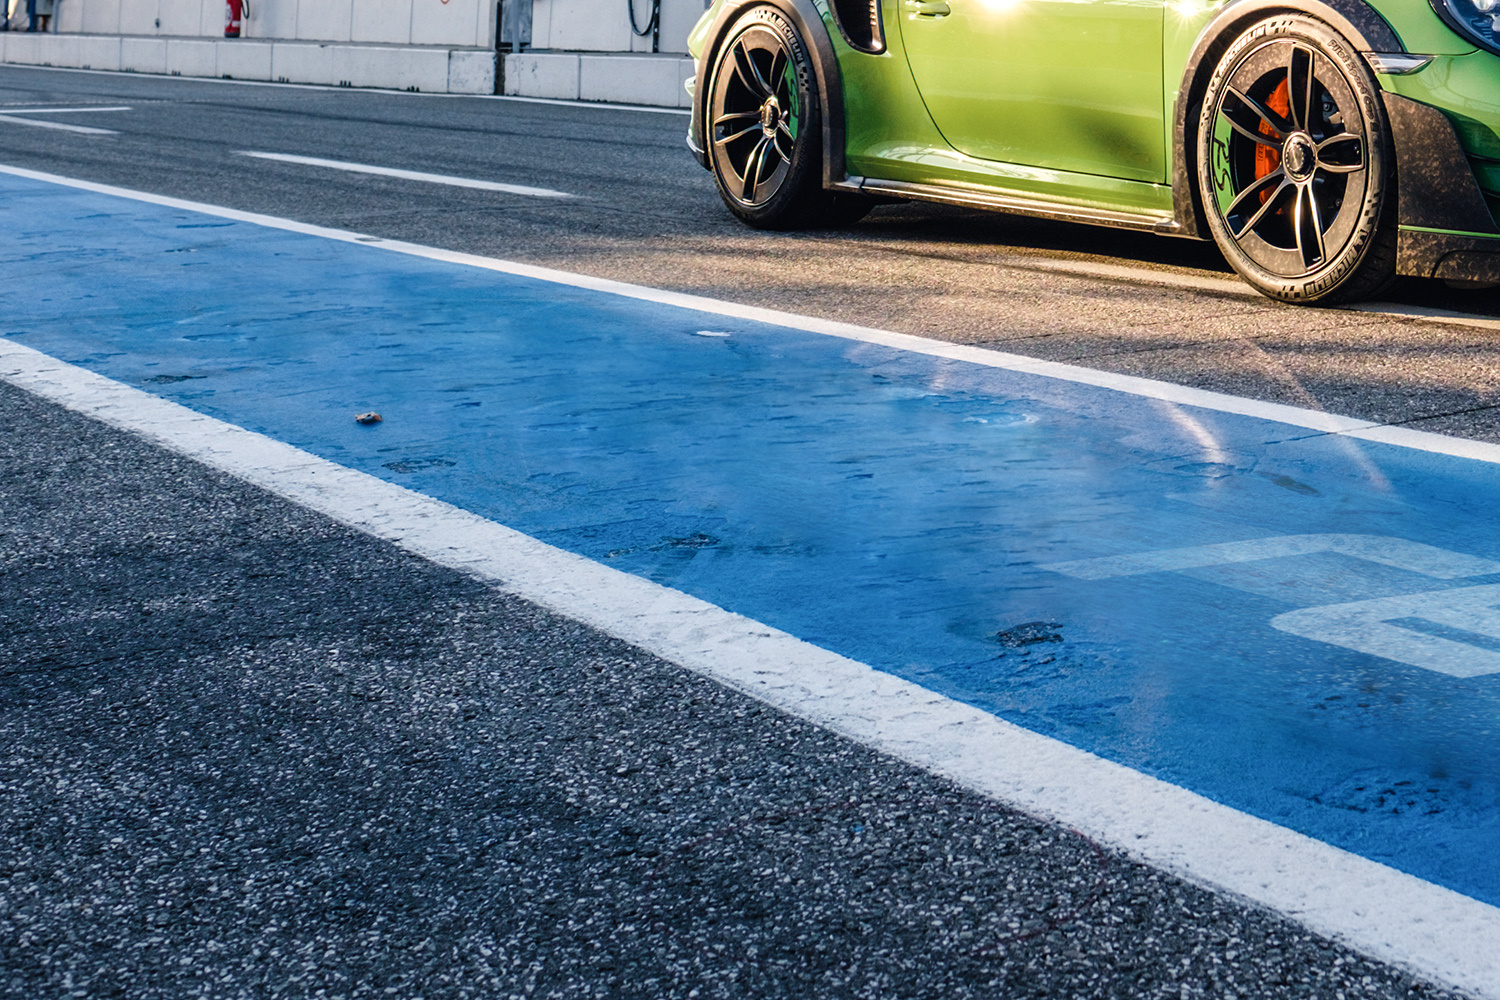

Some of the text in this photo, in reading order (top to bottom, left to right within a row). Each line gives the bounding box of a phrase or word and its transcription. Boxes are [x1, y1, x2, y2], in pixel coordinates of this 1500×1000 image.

[776, 17, 804, 65] MICHELIN
[1218, 24, 1267, 78] MICHELIN
[1327, 39, 1351, 62] Pilot
[1303, 246, 1358, 297] MICHELIN
